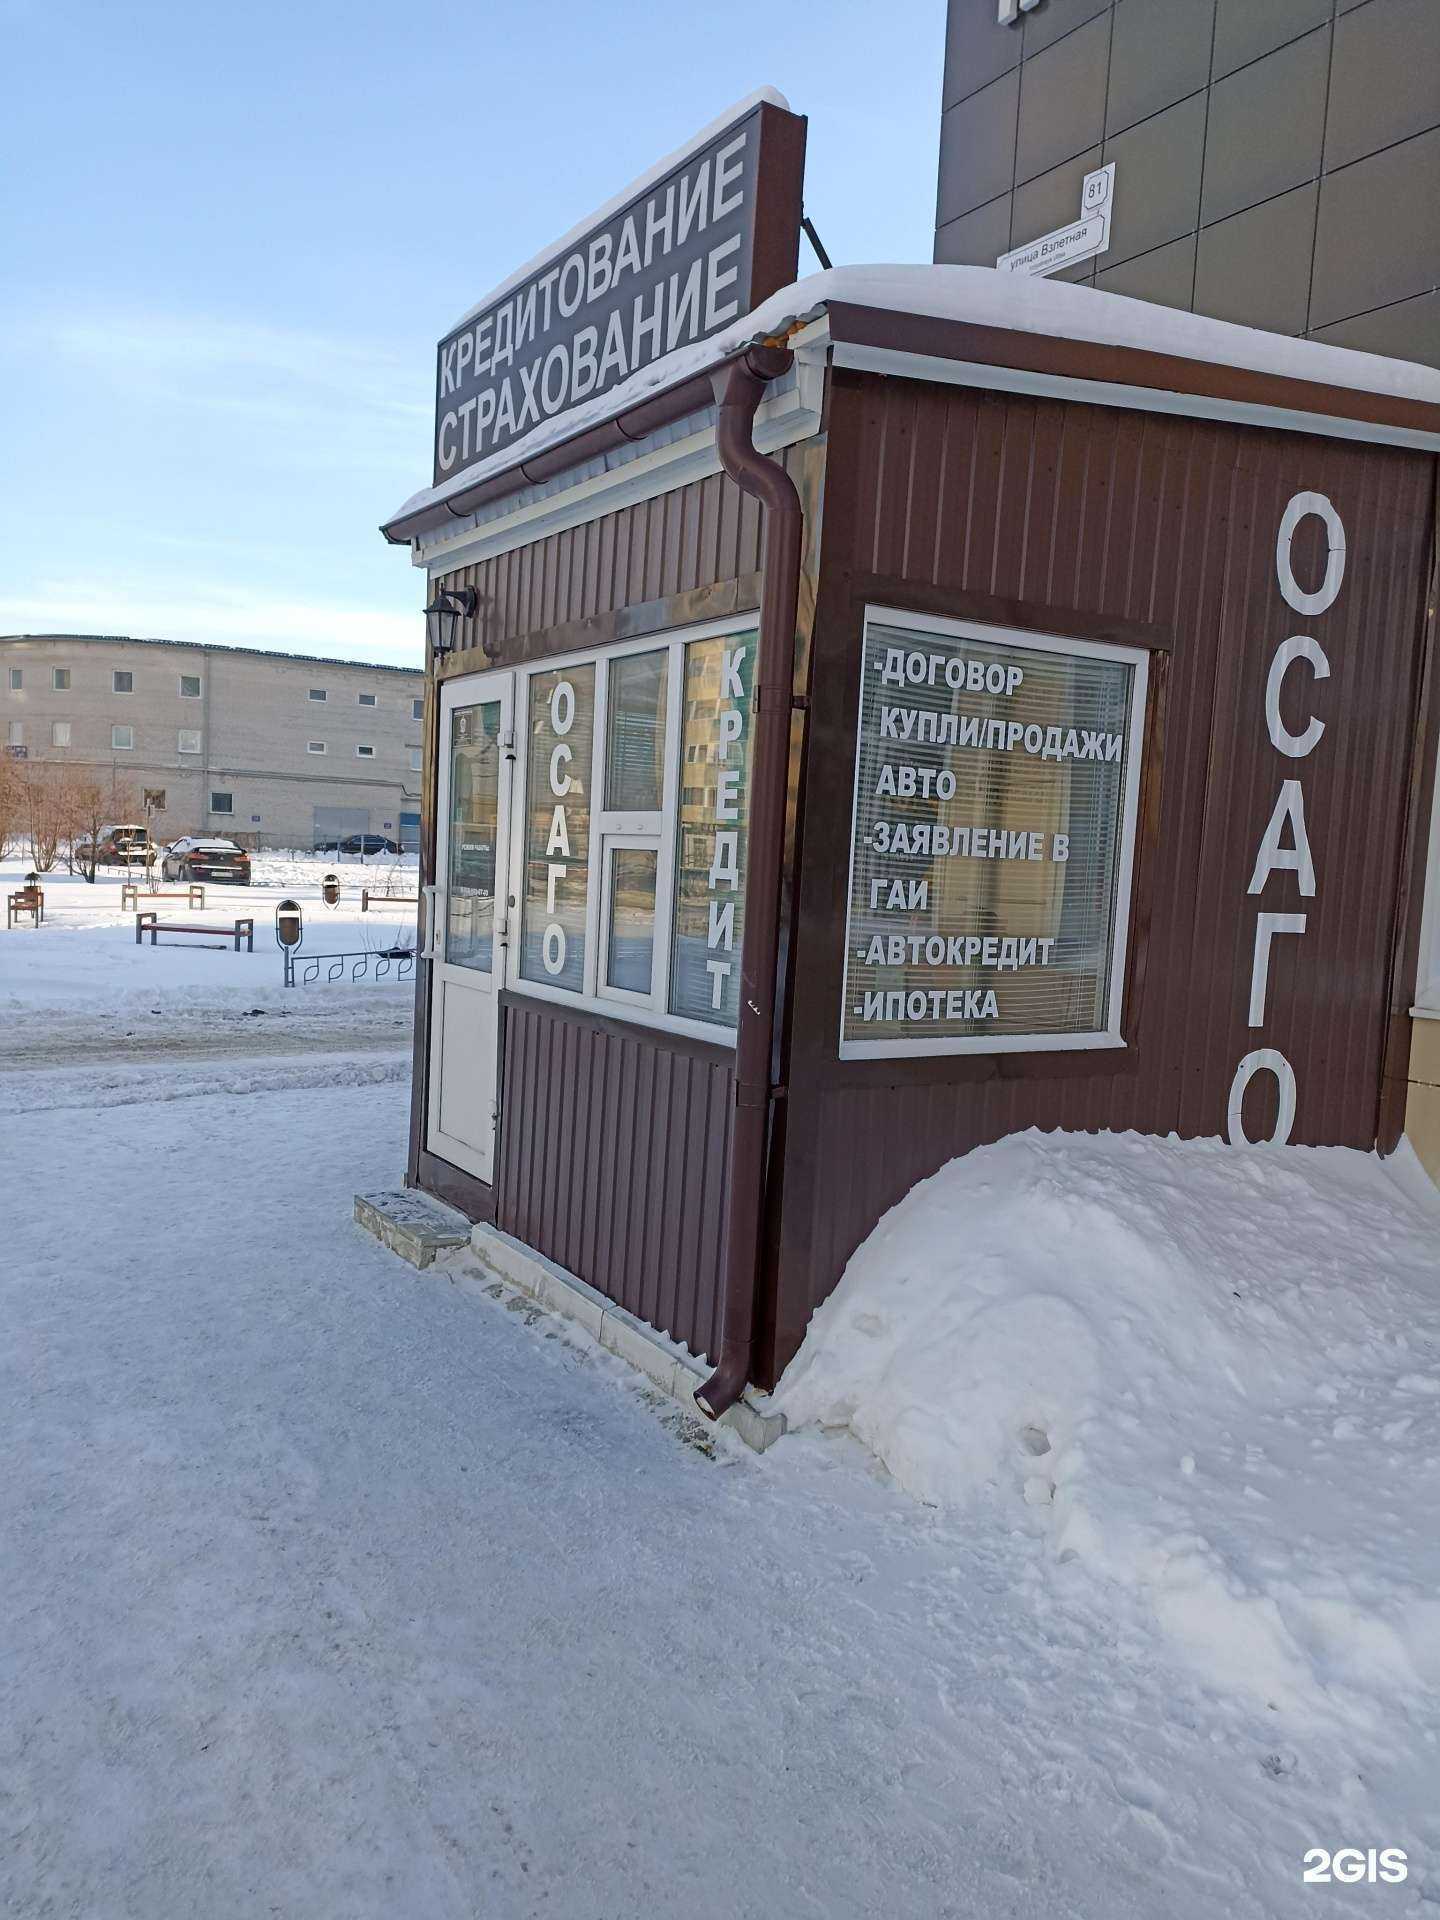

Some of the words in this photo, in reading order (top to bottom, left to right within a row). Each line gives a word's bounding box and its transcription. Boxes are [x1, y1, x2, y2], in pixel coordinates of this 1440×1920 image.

[1088, 182, 1102, 198] 81
[440, 132, 746, 398] КРЕДИТОВАНИЕ
[1010, 250, 1038, 272] улица
[1041, 228, 1087, 256] Взлетная
[439, 233, 741, 471] СТРАХОВАНИЕ
[874, 648, 1024, 696] -ДОГОВОР
[880, 706, 1122, 762] КУПЛИ/ПРОДАЖИ
[875, 764, 957, 801] АВТО
[542, 681, 576, 975] ОСАГО
[706, 646, 746, 1010] КРЕДИТ
[1227, 491, 1346, 1145] ОСАГО
[864, 821, 1044, 861] -ЗАЯВЛЕНИЕ
[1053, 834, 1069, 862] В
[870, 878, 928, 910] ГАИ
[857, 935, 1054, 971] -АВТОКРЕДИТ
[853, 990, 999, 1021] -ИПОТЕКА
